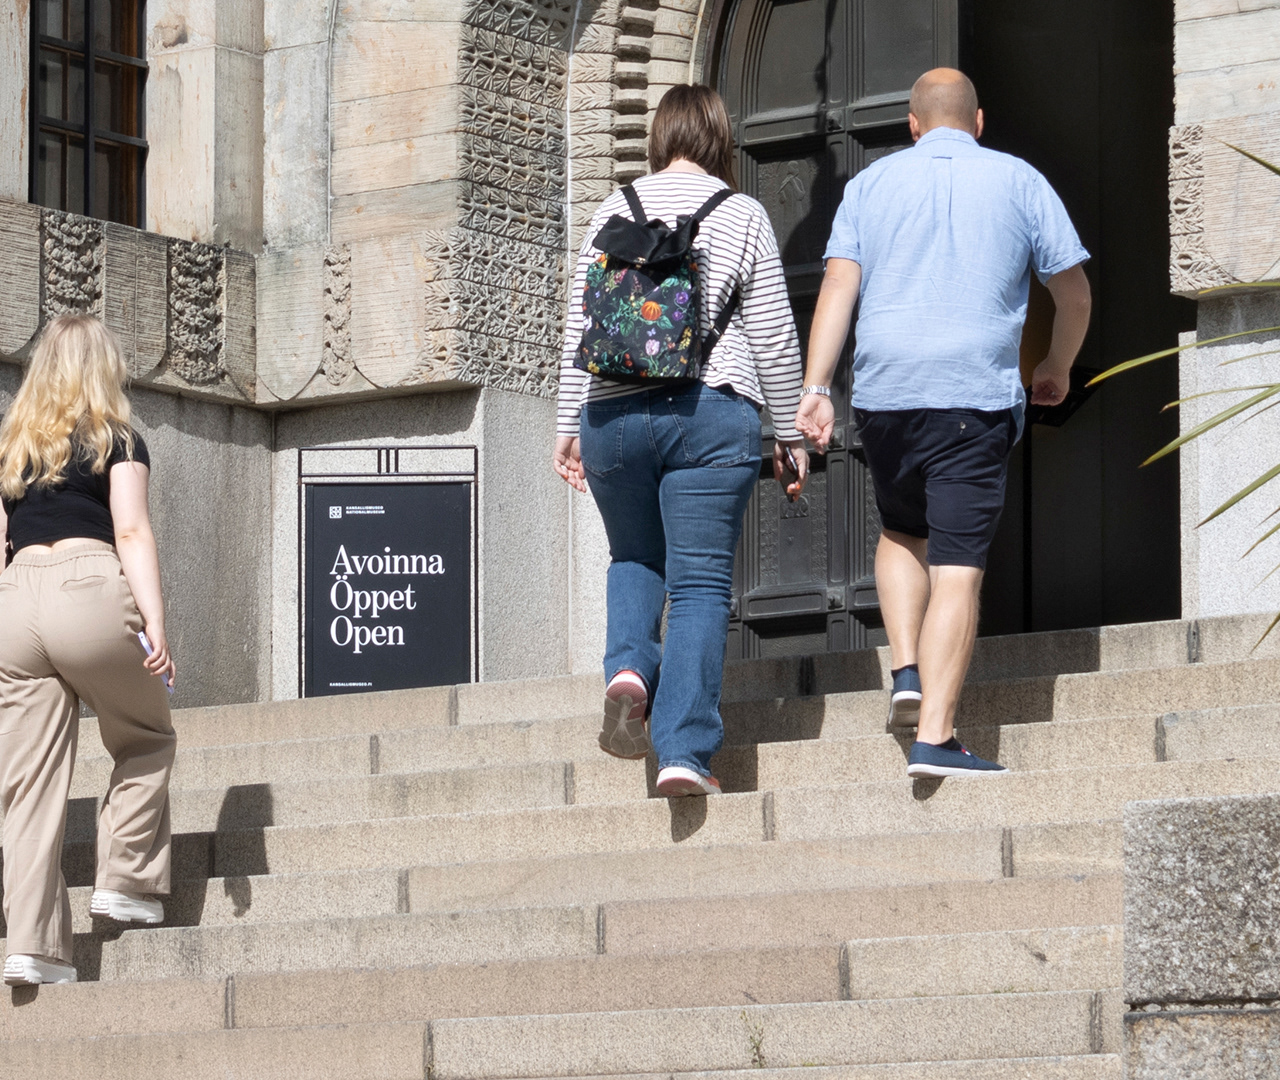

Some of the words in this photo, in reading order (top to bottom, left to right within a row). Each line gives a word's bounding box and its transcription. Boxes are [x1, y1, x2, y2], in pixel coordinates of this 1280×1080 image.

[329, 544, 446, 575] Avoinna
[330, 575, 417, 618] Öppet
[330, 615, 405, 654] Open
